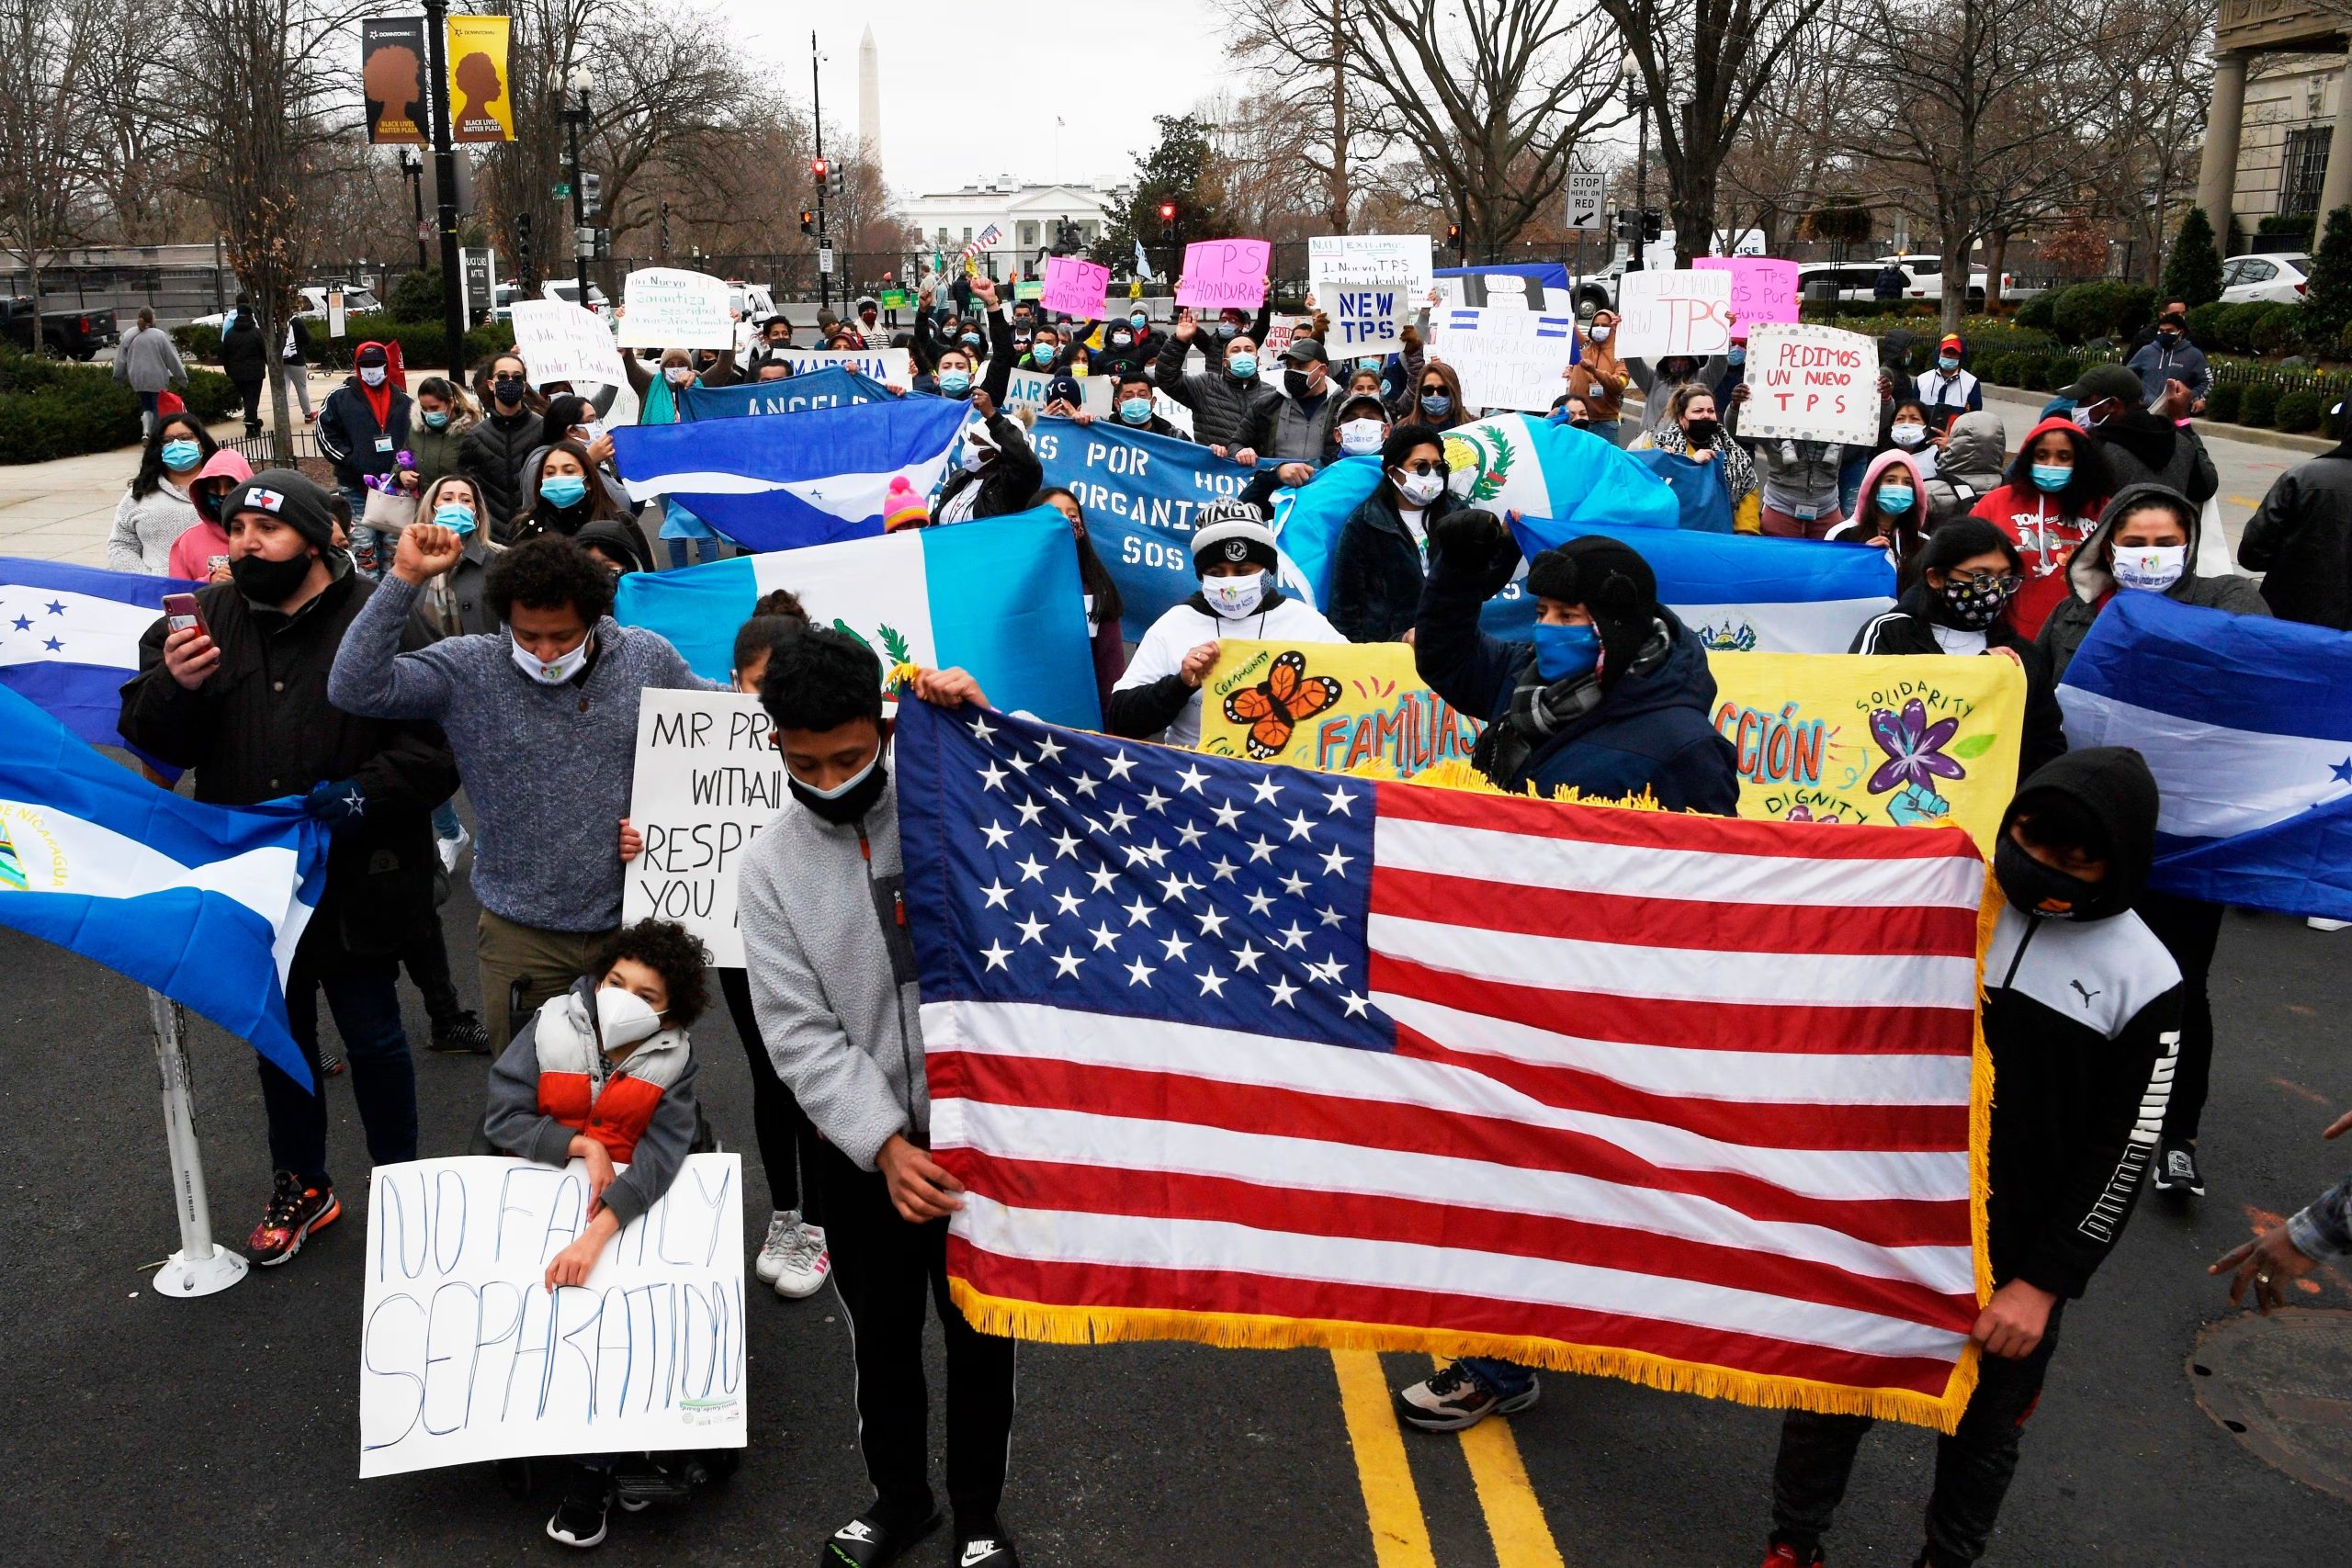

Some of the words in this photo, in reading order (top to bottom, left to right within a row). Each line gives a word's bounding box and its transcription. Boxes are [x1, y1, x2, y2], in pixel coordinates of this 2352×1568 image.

[1573, 177, 1600, 187] STOP
[1575, 198, 1595, 209] RED
[1715, 246, 1759, 254] PLICE
[1195, 280, 1265, 303] HONDURAS
[1339, 292, 1394, 318] NEW
[1341, 320, 1395, 344] TPS
[1656, 299, 1731, 355] TPS
[1779, 343, 1861, 368] PEDIMOS
[1767, 369, 1791, 387] UN
[1804, 370, 1851, 387] NUEVO
[1087, 442, 1149, 477] POR
[2011, 513, 2041, 526] TOM
[1123, 536, 1185, 571] SOS
[1214, 649, 1270, 696] COMMUNITY
[1856, 680, 1974, 719] SOLIDARITY
[1714, 701, 1824, 784] CCIÓN
[1764, 788, 1869, 825] DIGNITY
[15, 807, 69, 886] NICARAGUA
[379, 1168, 467, 1282] NO
[362, 1275, 742, 1451] SEPARATION
[966, 1540, 995, 1557] NIKE
